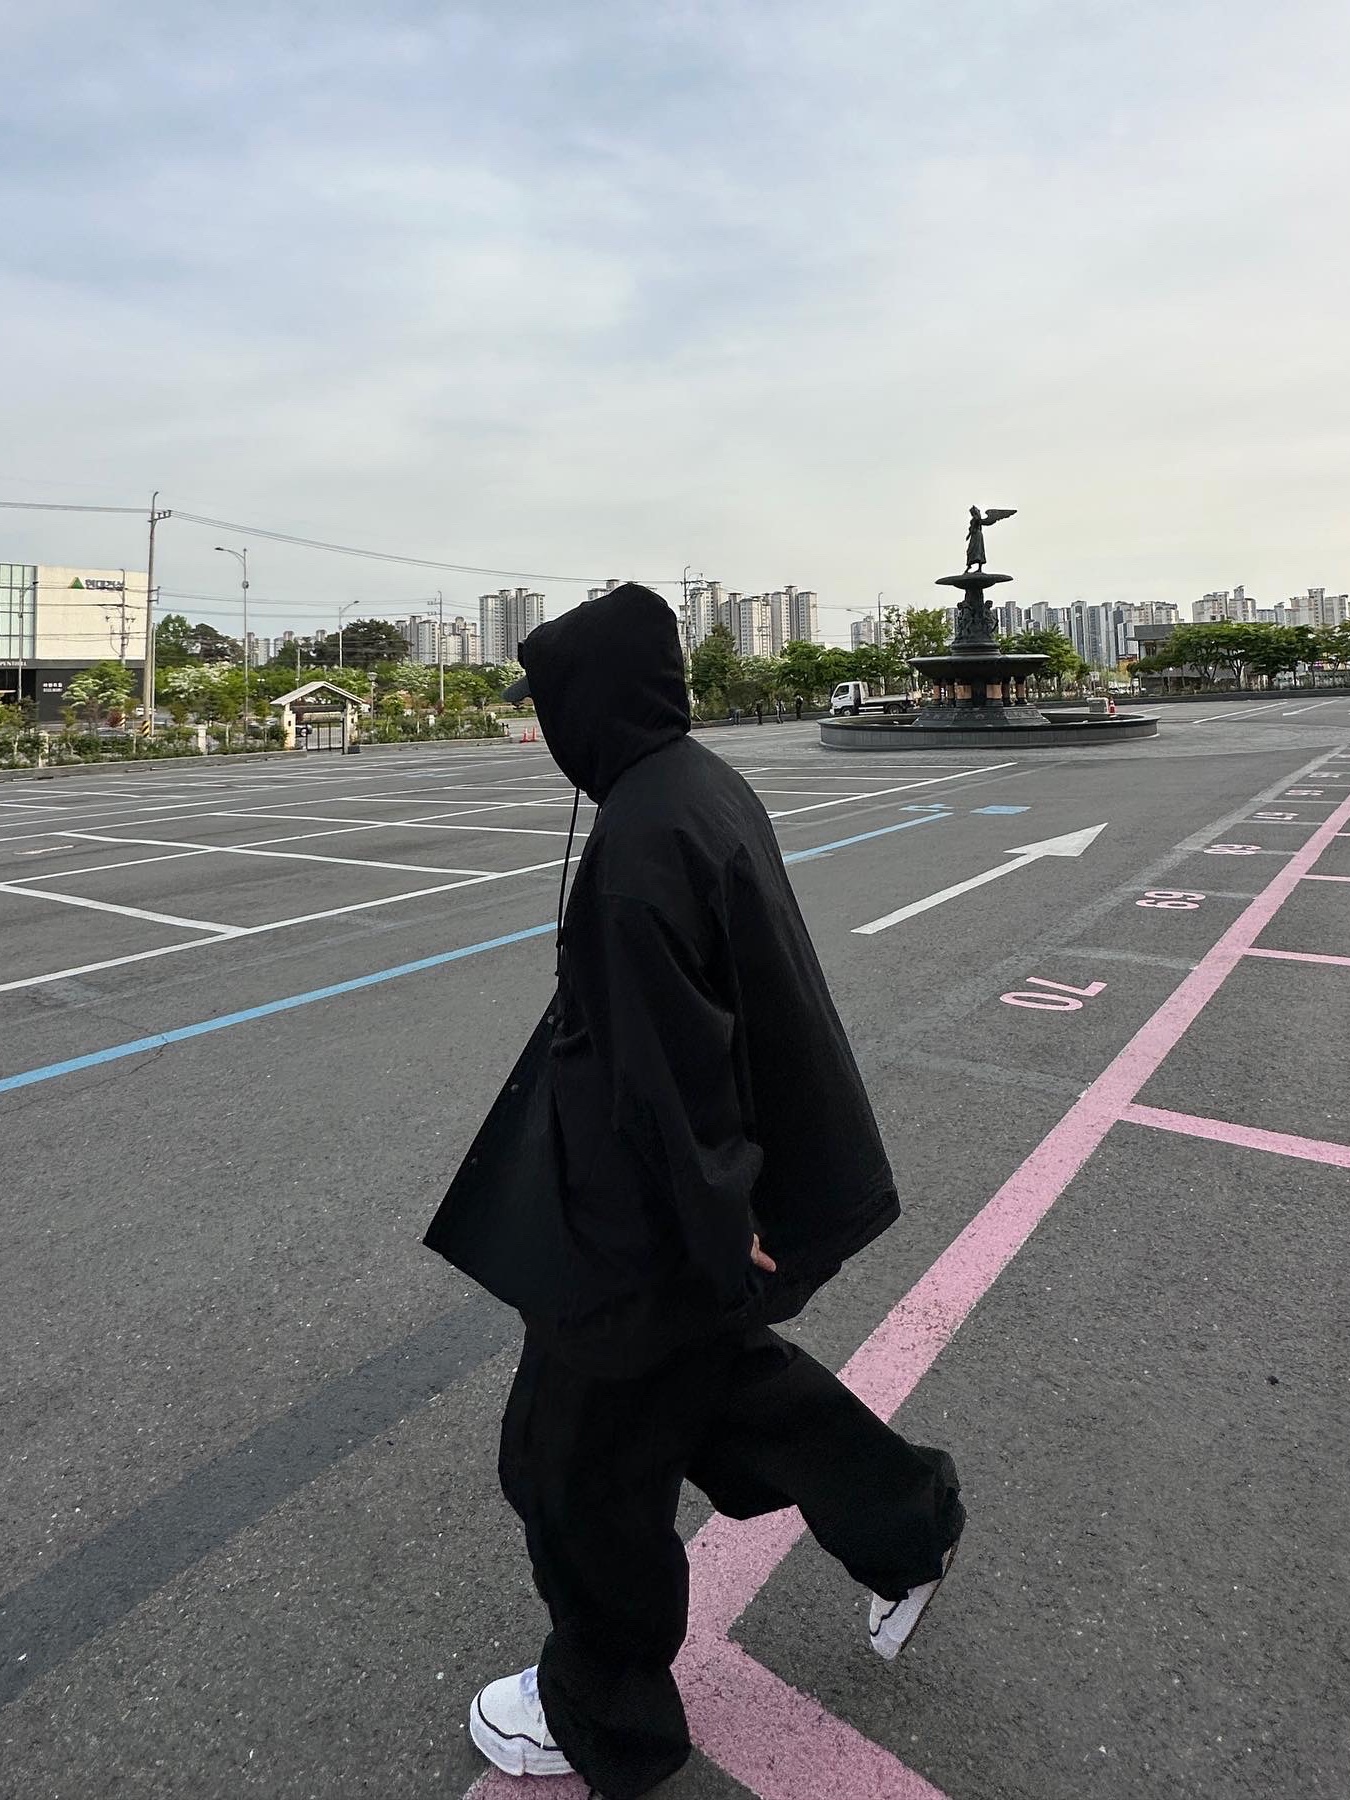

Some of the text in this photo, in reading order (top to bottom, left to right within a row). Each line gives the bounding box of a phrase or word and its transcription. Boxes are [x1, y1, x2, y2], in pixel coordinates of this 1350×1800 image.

[1252, 811, 1299, 820] 67
[1203, 844, 1261, 855] 68
[1135, 891, 1206, 910] 69
[999, 976, 1108, 1011] 70
